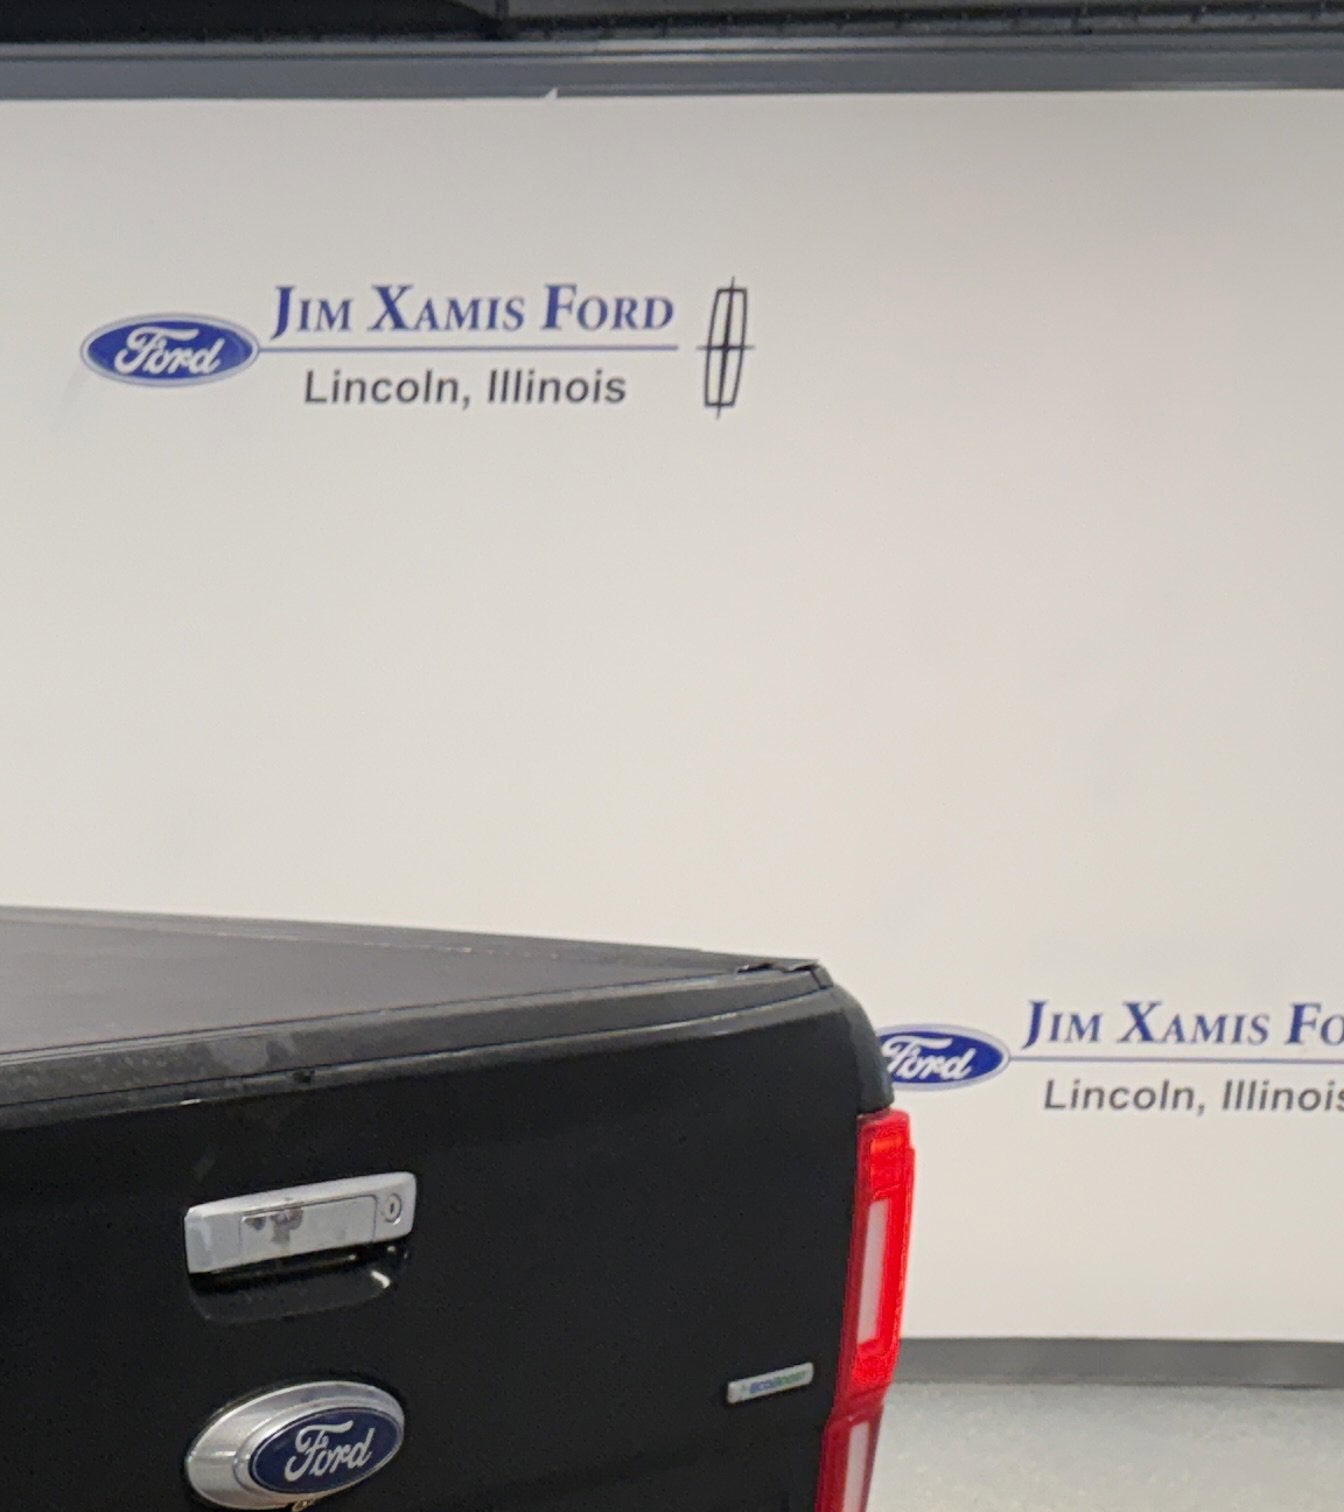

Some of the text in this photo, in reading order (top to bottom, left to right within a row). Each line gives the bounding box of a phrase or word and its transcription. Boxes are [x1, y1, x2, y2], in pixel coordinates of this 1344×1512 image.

[270, 284, 674, 340] JIM XAMIS FORD
[114, 324, 222, 375] Ford
[303, 369, 627, 409] Lincoln, Illinois
[1022, 1000, 1103, 1050] JIM
[1116, 1001, 1270, 1045] XAMIS
[881, 1035, 976, 1079] Ford
[1044, 1079, 1206, 1115] Lincoln,
[284, 1420, 375, 1482] Ford
